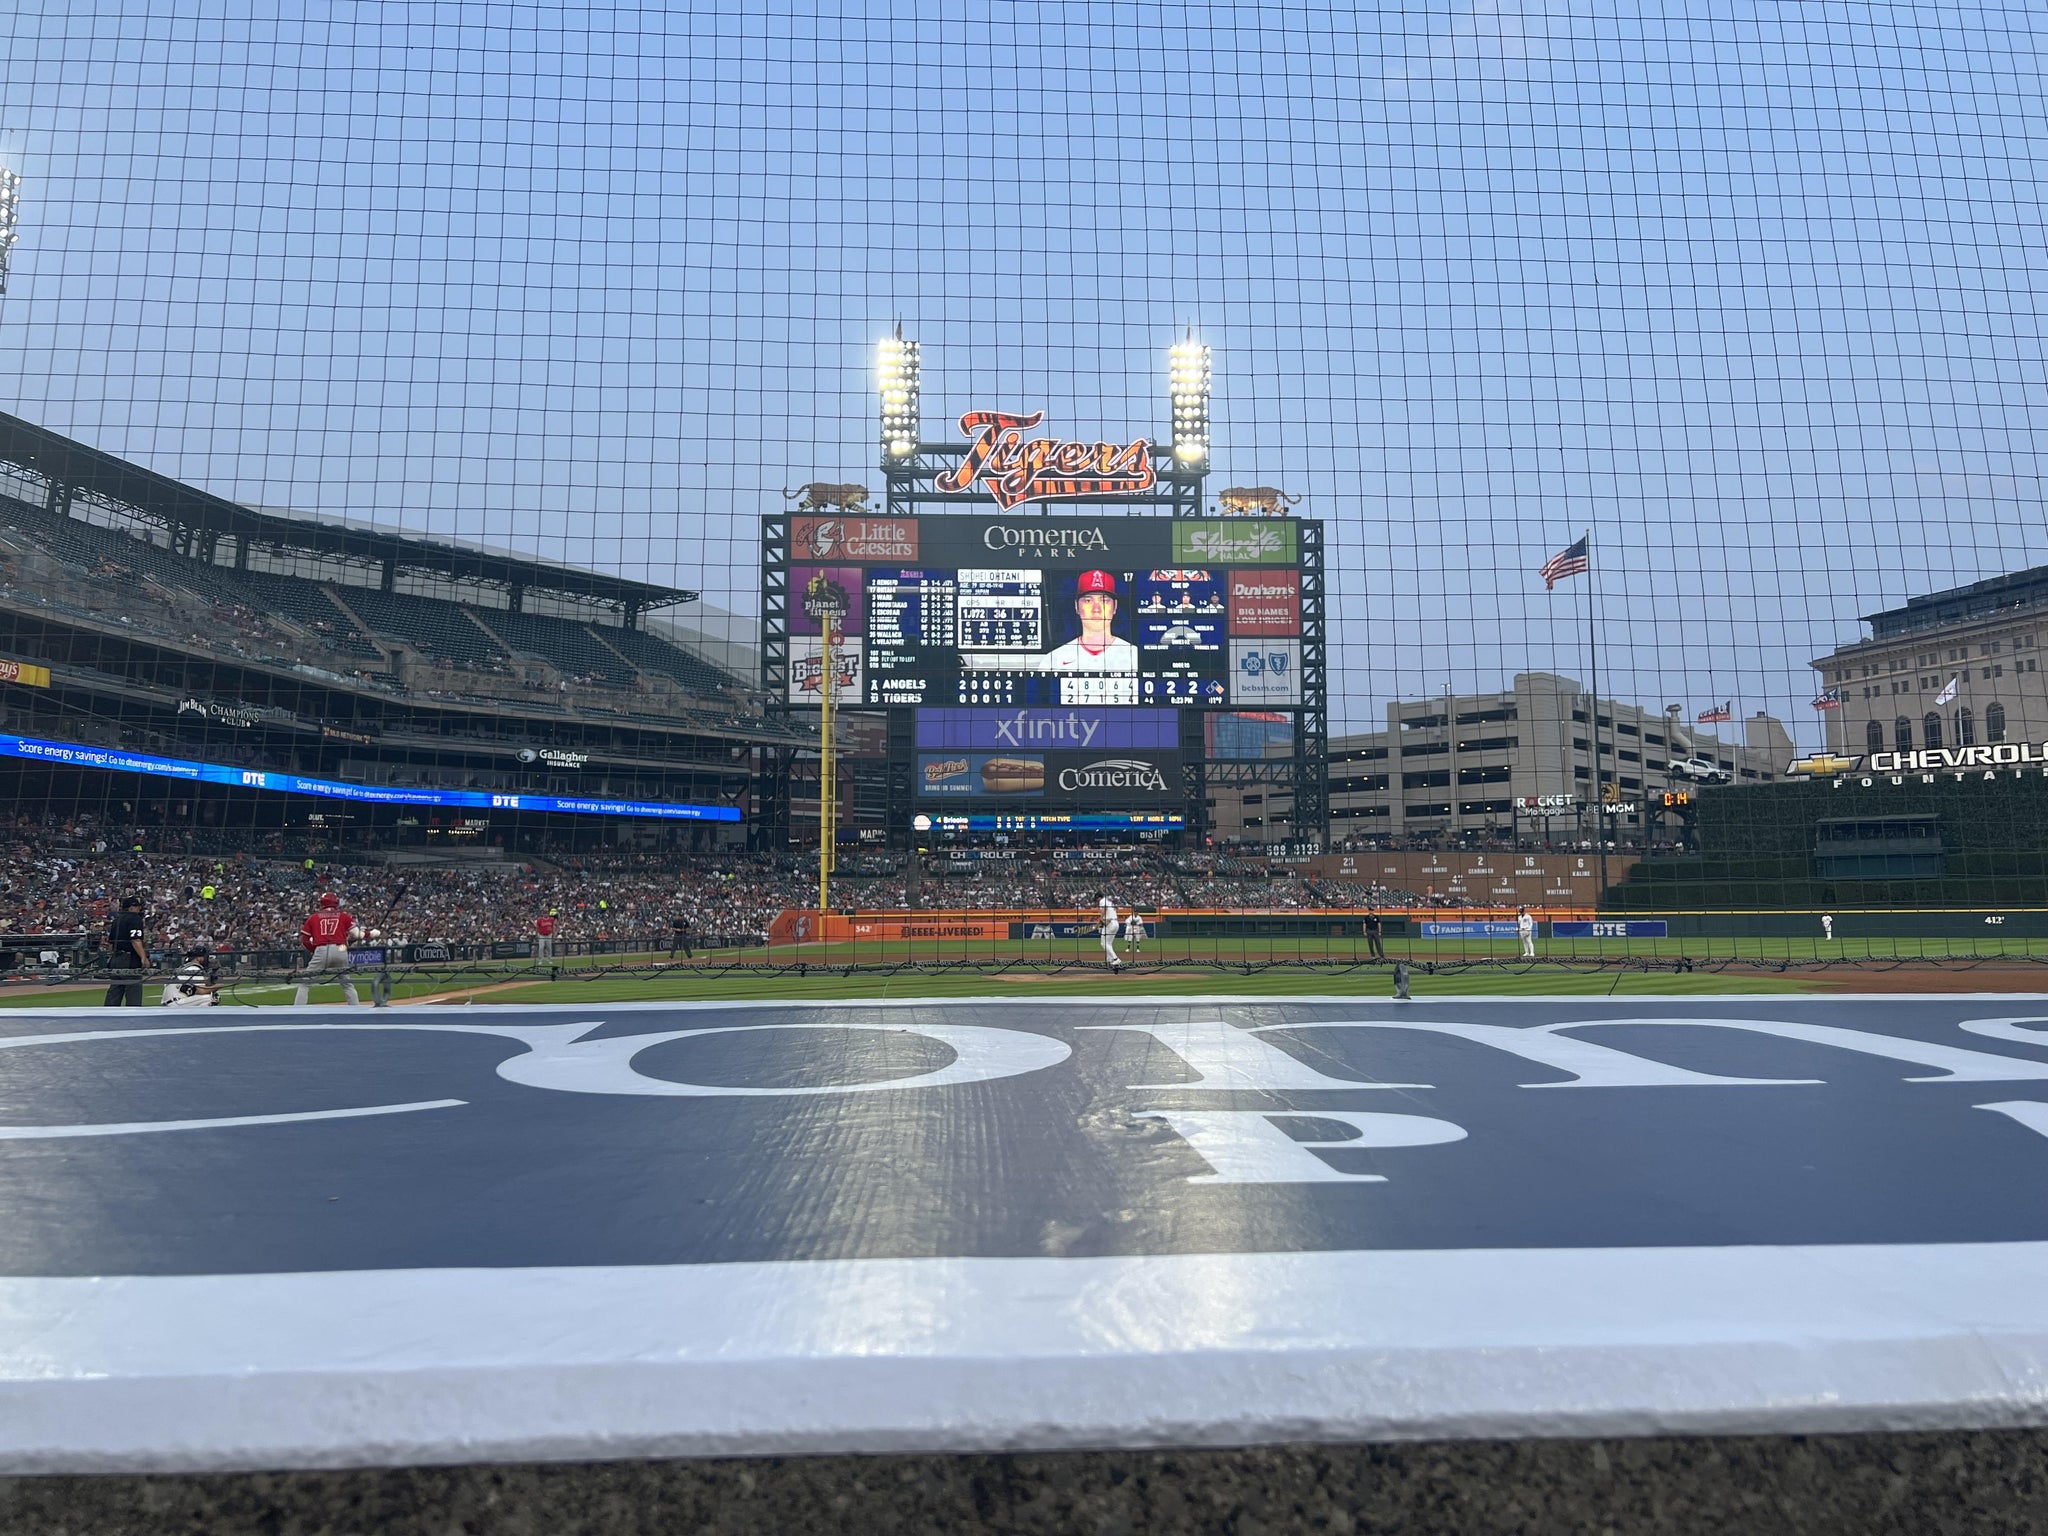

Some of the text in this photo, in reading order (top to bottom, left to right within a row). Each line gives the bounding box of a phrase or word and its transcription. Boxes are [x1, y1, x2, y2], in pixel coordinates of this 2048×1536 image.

[935, 410, 1157, 512] Tigers
[860, 522, 906, 541] Little
[984, 525, 1110, 551] Comerica
[846, 537, 913, 556] Caesars
[1018, 548, 1077, 558] PARK
[1222, 552, 1251, 561] HALAL
[960, 572, 1020, 581] SHOHEI OHTANI
[1123, 572, 1134, 583] 17
[1233, 584, 1296, 596] Dunham's
[804, 599, 840, 611] planet
[810, 608, 847, 618] fitness
[993, 609, 1007, 619] 36
[1020, 609, 1034, 619] 77
[1239, 608, 1289, 616] BIG NAMES
[0, 661, 19, 680] ays
[882, 679, 1133, 690] ANGELS 2 0 0 0 2 4 8 0 6 4
[1144, 680, 1198, 694] 0 2 2
[882, 693, 1133, 703] TIGERS 0 0 0 1 2 7 1 5 4
[178, 699, 207, 717] JIM BEAM
[210, 704, 260, 723] CHAMPIONS
[226, 718, 246, 728] CLUB
[994, 710, 1101, 748] xfinity
[18, 741, 43, 755] Score
[44, 747, 74, 761] energy
[75, 750, 108, 764] savings!
[109, 756, 118, 764] Go
[119, 757, 126, 765] to
[539, 749, 589, 762] Gallagher
[1870, 741, 2048, 772] CHEVROL
[546, 760, 580, 768] INSURANCE
[242, 771, 266, 787] DTE
[1058, 768, 1169, 791] Comerica
[1833, 768, 2048, 788] FOUNTAI
[297, 780, 312, 791] Score
[313, 783, 331, 794] energy
[492, 795, 519, 807] DTE
[1516, 794, 1574, 808] ROCKET
[1664, 792, 1689, 807] 0:14
[557, 800, 626, 813] Score energy savings!
[1525, 807, 1566, 817] Mortgage
[950, 851, 1017, 860] CHEVROLET
[1053, 850, 1119, 859] CHEVROLET
[1431, 855, 1437, 864] 5
[1477, 856, 1484, 866] 2
[1524, 857, 1535, 866] 16
[1577, 858, 1584, 868] 6
[1501, 877, 1508, 886] 3
[1556, 877, 1561, 886] 1
[1984, 916, 2005, 924] 412'
[320, 918, 339, 936] 17
[1593, 922, 1626, 937] DTE
[130, 929, 142, 938] 73
[356, 951, 382, 963] mobile
